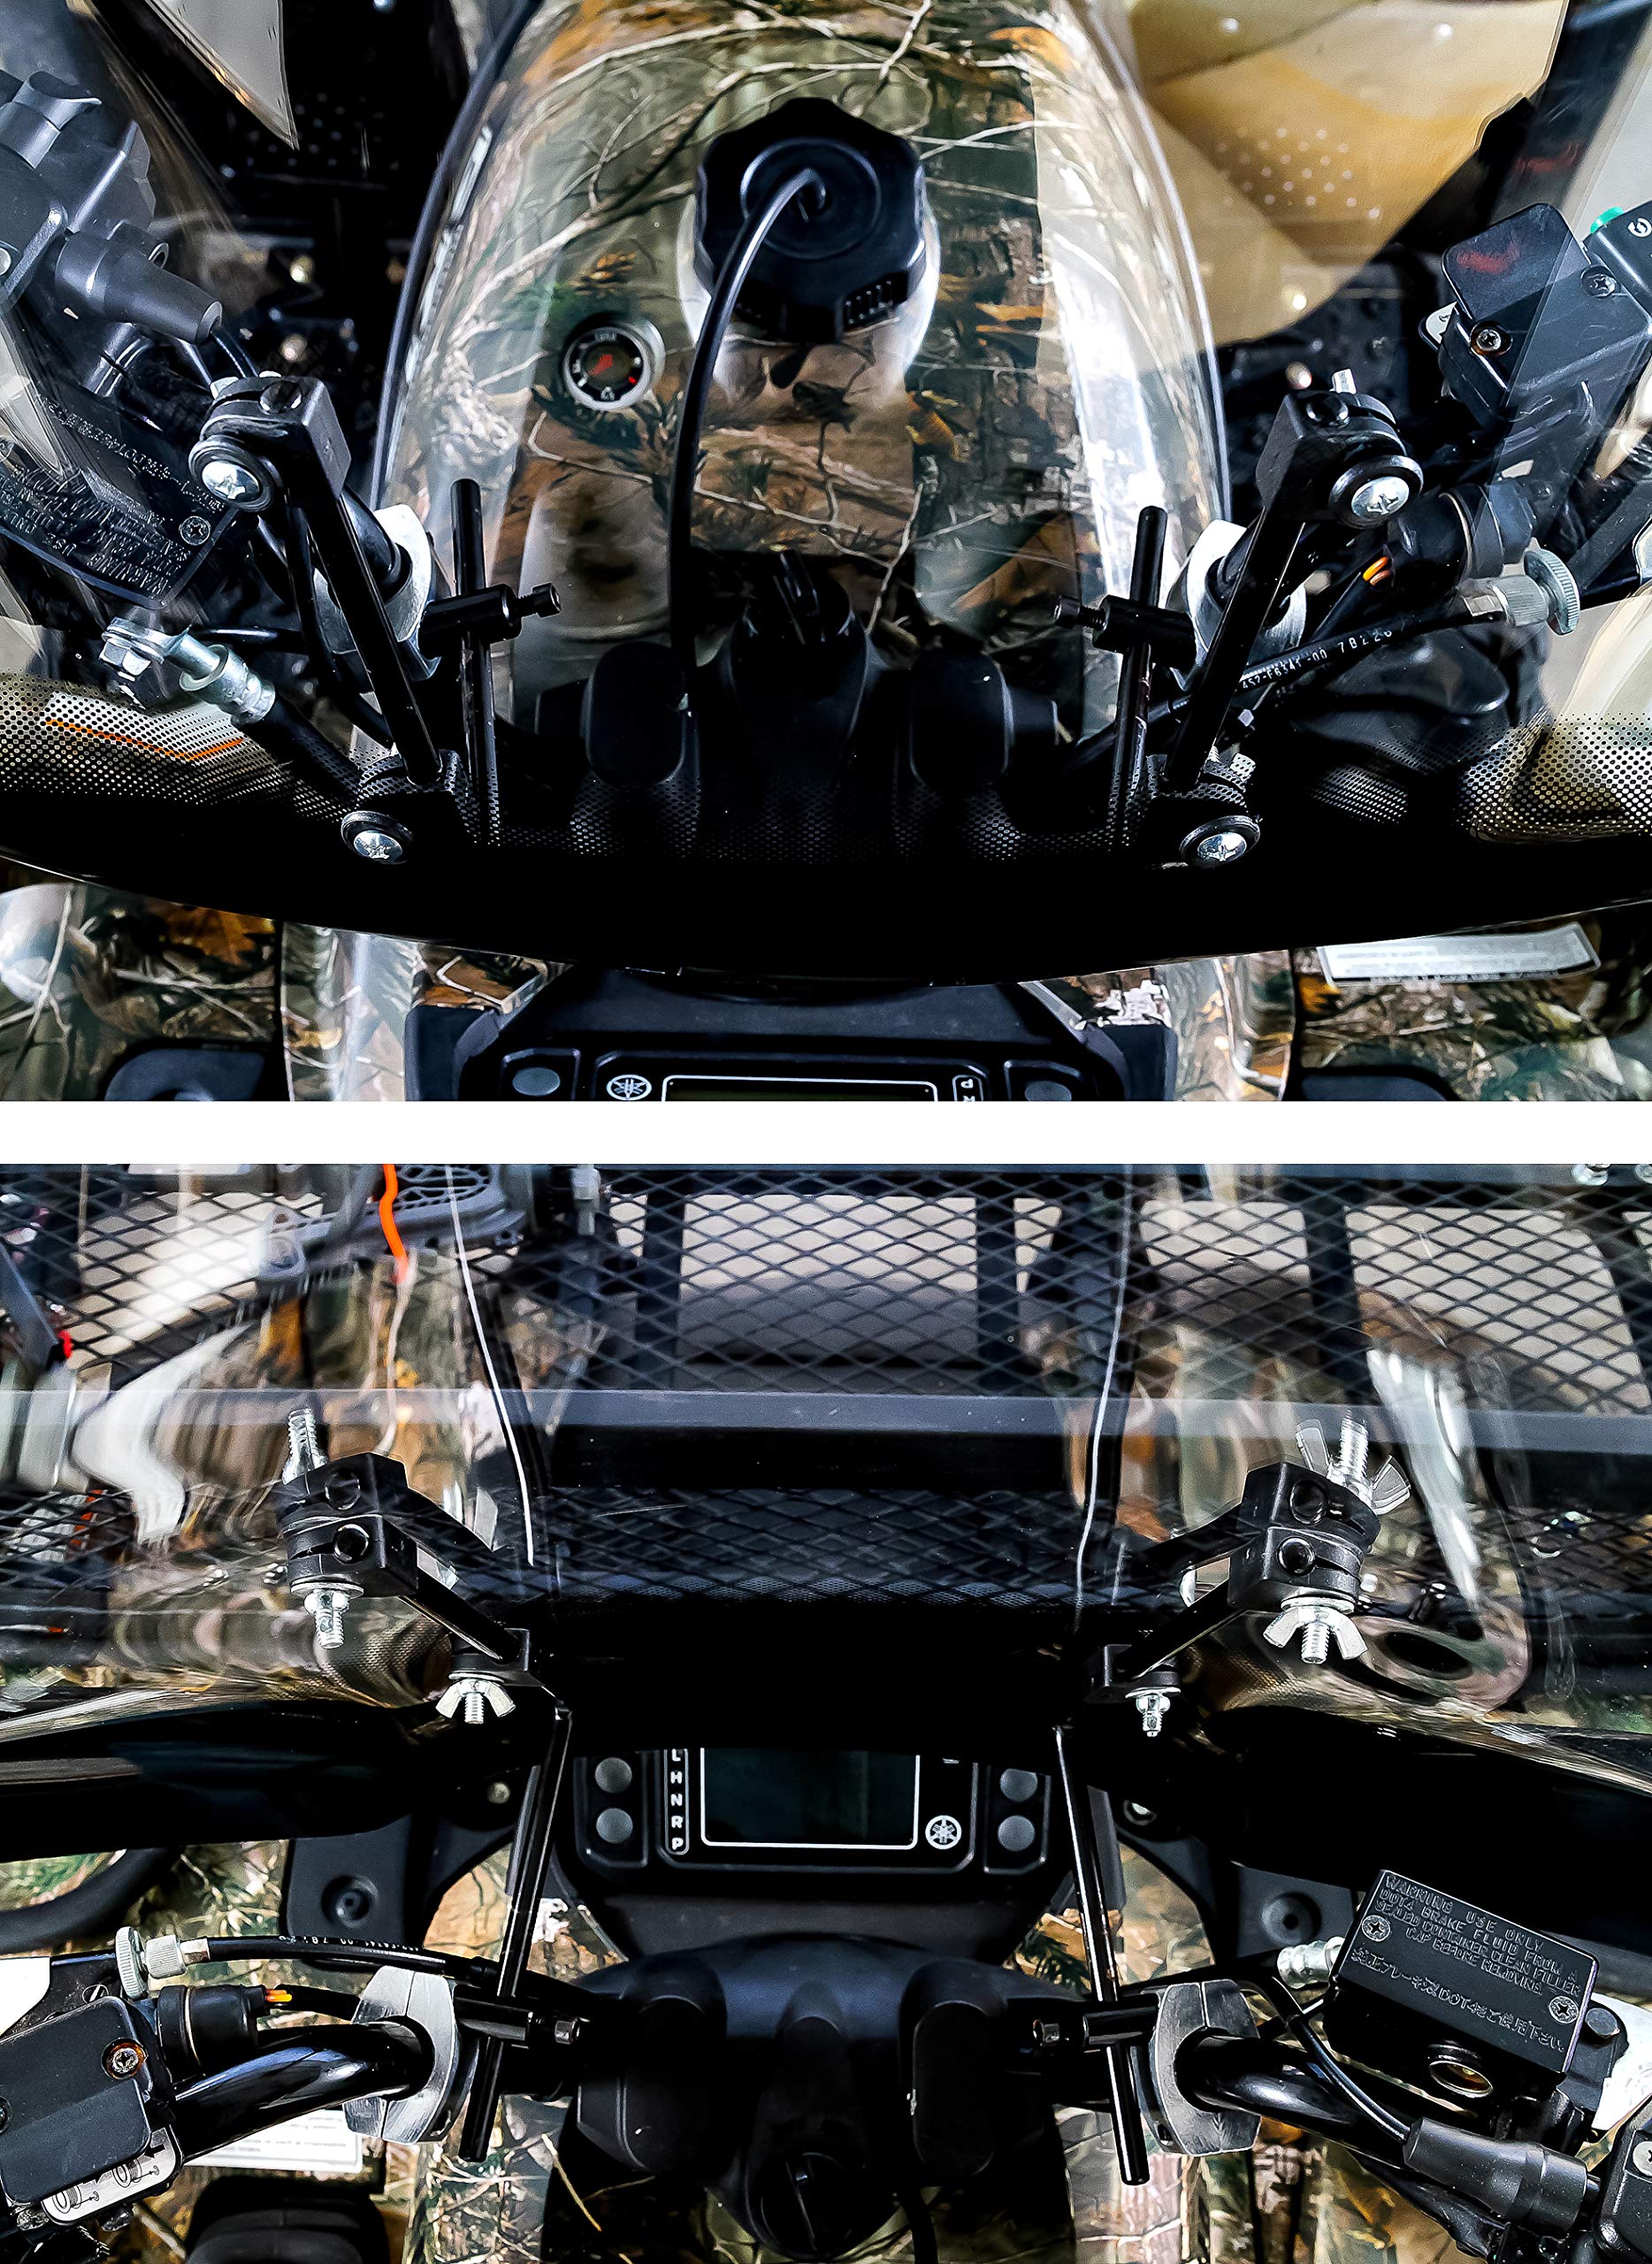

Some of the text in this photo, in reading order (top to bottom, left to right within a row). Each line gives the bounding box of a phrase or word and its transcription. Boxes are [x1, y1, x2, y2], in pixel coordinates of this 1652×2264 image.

[42, 532, 77, 557] USE
[86, 553, 169, 598] WARNING
[671, 1748, 681, 1762] L
[670, 1771, 683, 1784] H
[670, 1793, 683, 1807] N
[671, 1815, 684, 1828] R
[671, 1837, 684, 1850] P
[1386, 1875, 1544, 1952] WARNING USE ONLY
[1375, 1900, 1420, 1926] SEALED
[1491, 1950, 1531, 1976] CLEAN
[1533, 1968, 1581, 1997] FILLER
[1380, 1889, 1578, 1983] DOT4 BRAKE FLUID FROM A
[1406, 1928, 1433, 1944] CAP
[1433, 1938, 1478, 1967] BEFORE
